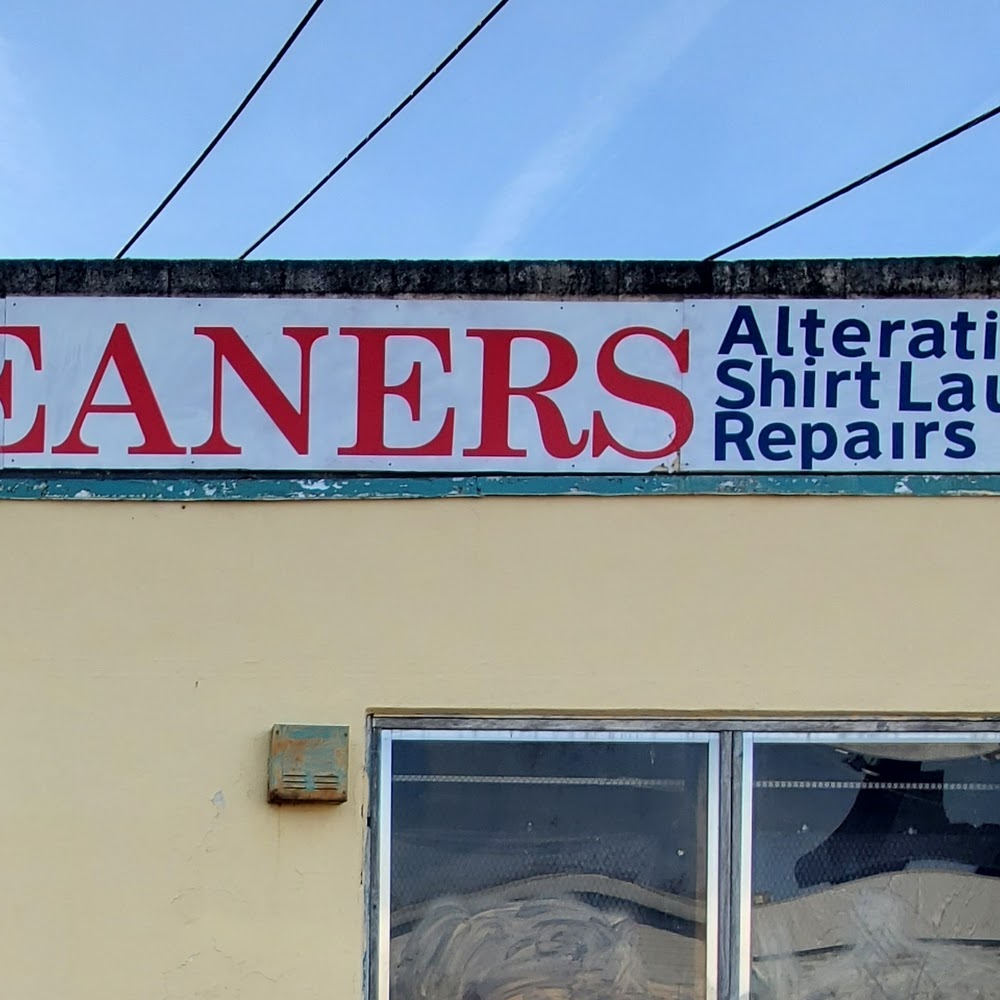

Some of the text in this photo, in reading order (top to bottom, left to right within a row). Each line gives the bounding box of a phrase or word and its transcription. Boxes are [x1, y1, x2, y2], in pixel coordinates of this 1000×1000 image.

[717, 305, 998, 360] Alterati
[715, 356, 881, 410] Shirt
[714, 411, 977, 470] Repairs
